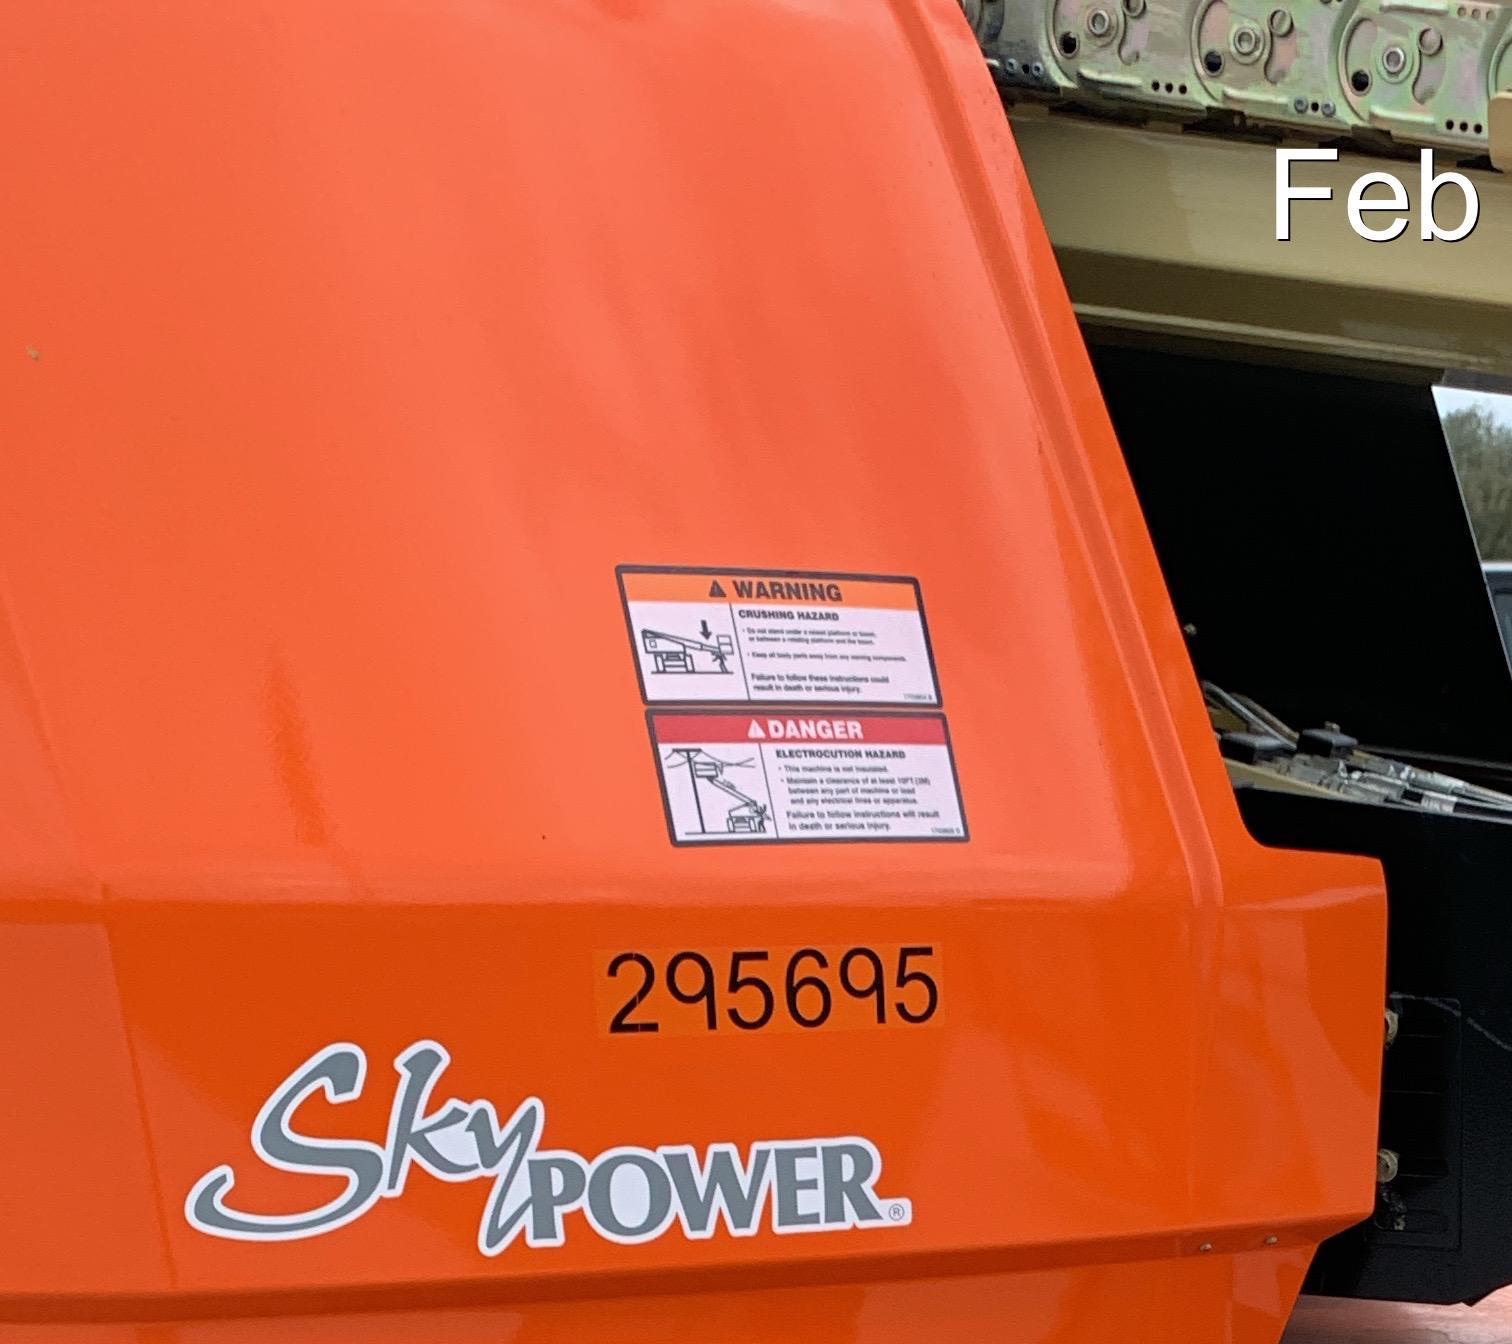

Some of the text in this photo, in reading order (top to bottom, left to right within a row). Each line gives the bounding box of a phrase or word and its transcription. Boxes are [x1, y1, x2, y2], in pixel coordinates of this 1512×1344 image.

[733, 580, 843, 602] WARNING
[738, 609, 839, 621] CRUSHING HAZARD
[751, 673, 776, 681] Failure
[786, 673, 807, 682] follow
[808, 674, 828, 682] these
[829, 674, 869, 683] instructions
[870, 676, 890, 684] could
[783, 684, 804, 692] death
[767, 719, 864, 739] DANGER
[775, 749, 906, 759] ELECTROCUTION HAZARD
[786, 810, 940, 819] Failure to follow instructions will result
[788, 822, 797, 830] in
[798, 822, 823, 830] death
[835, 822, 865, 830] serious
[607, 946, 940, 1034] 295695
